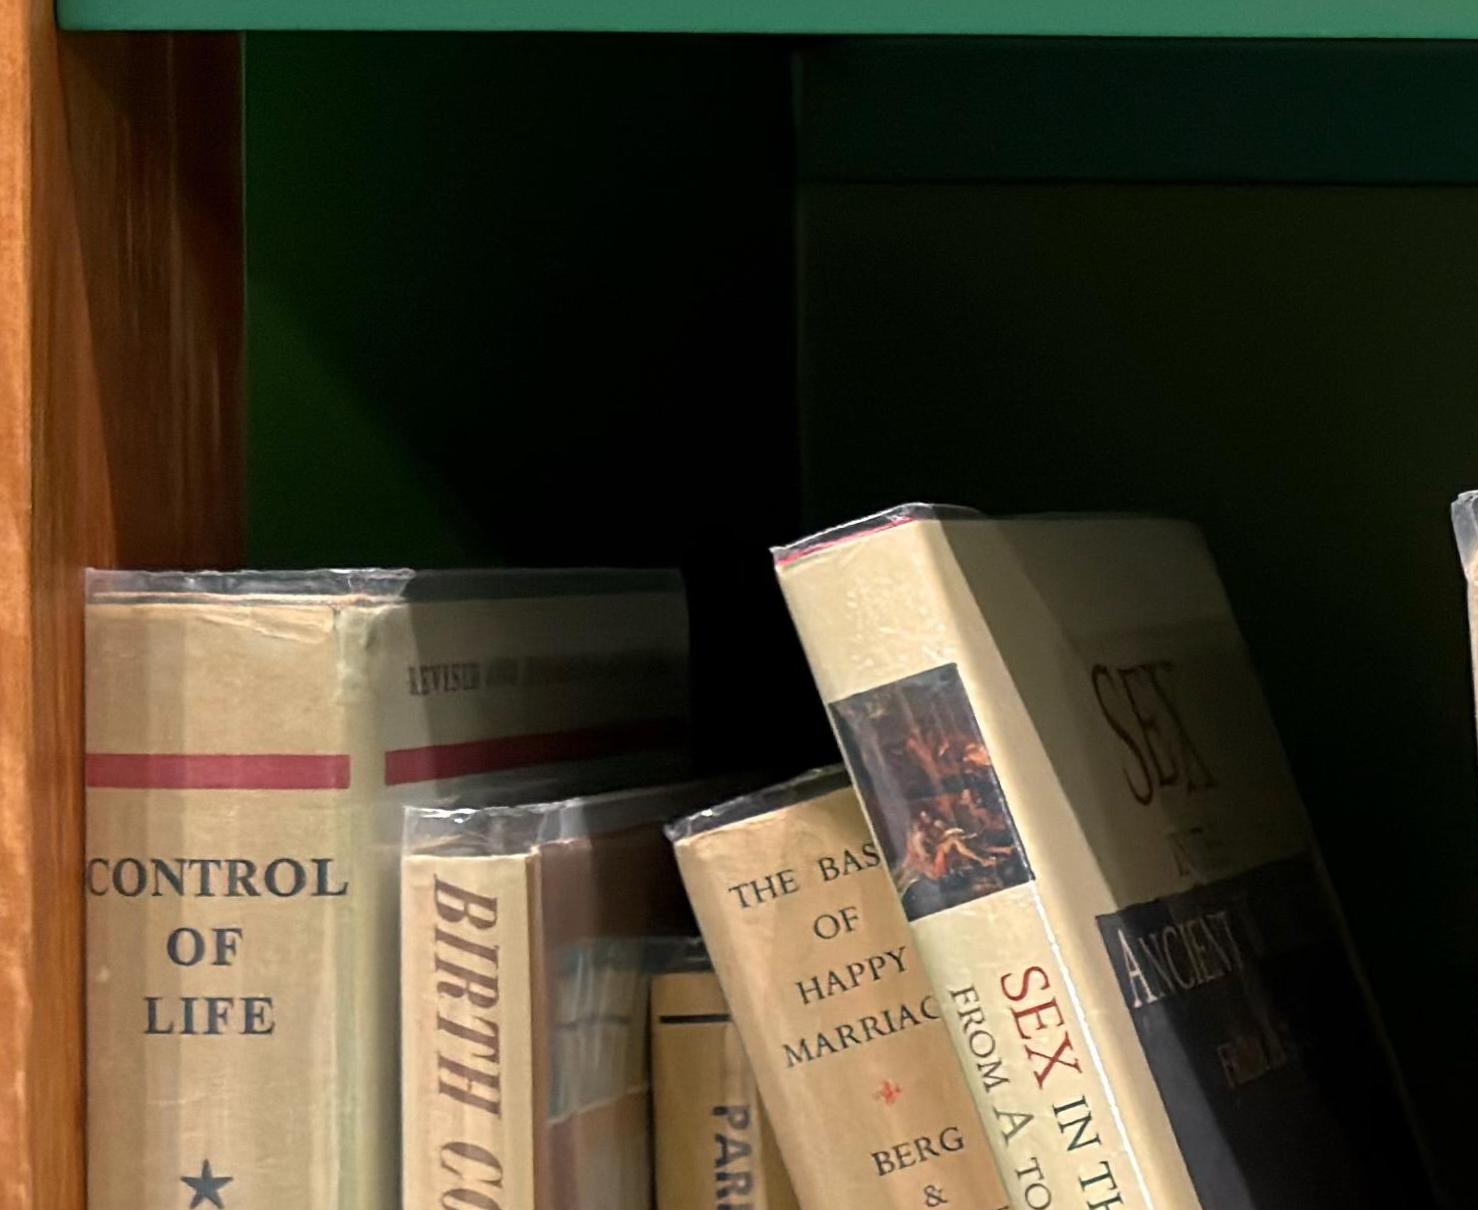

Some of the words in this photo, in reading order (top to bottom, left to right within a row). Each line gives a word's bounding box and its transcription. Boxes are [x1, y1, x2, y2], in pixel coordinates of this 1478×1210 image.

[86, 857, 348, 898] CONTROL
[813, 906, 860, 940] OF
[167, 927, 243, 967] OF
[433, 874, 501, 1114] BIRTH
[796, 946, 910, 1006] HAPPY
[143, 995, 274, 1037] LIFE
[1000, 966, 1082, 1089] SEX
[1053, 1096, 1101, 1152] IN
[871, 1126, 964, 1177] BERG
